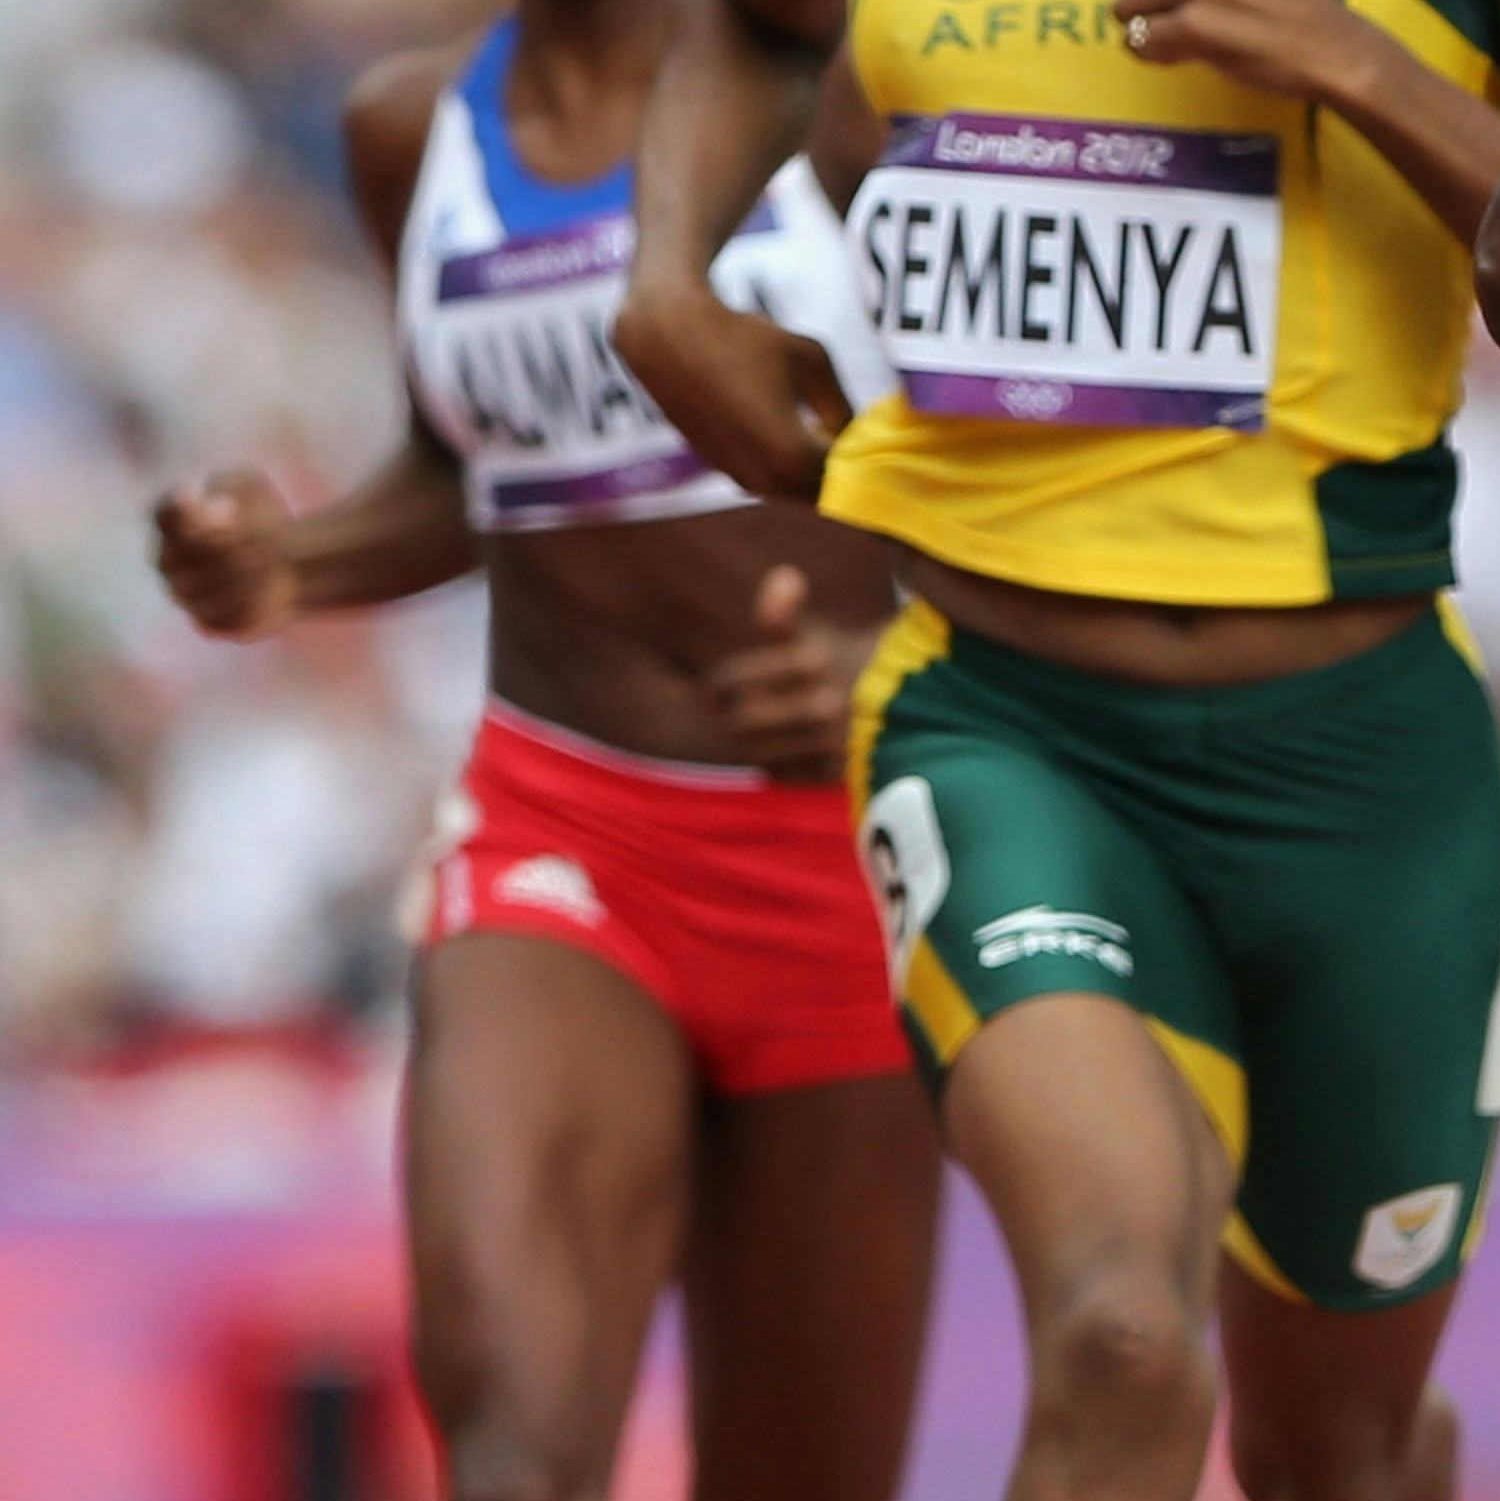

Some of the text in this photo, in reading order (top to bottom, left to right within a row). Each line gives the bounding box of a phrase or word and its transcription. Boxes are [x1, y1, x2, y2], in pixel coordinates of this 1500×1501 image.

[921, 0, 1107, 57] AFRI
[934, 120, 1174, 179] London 2012
[865, 202, 1253, 356] SEMENYA
